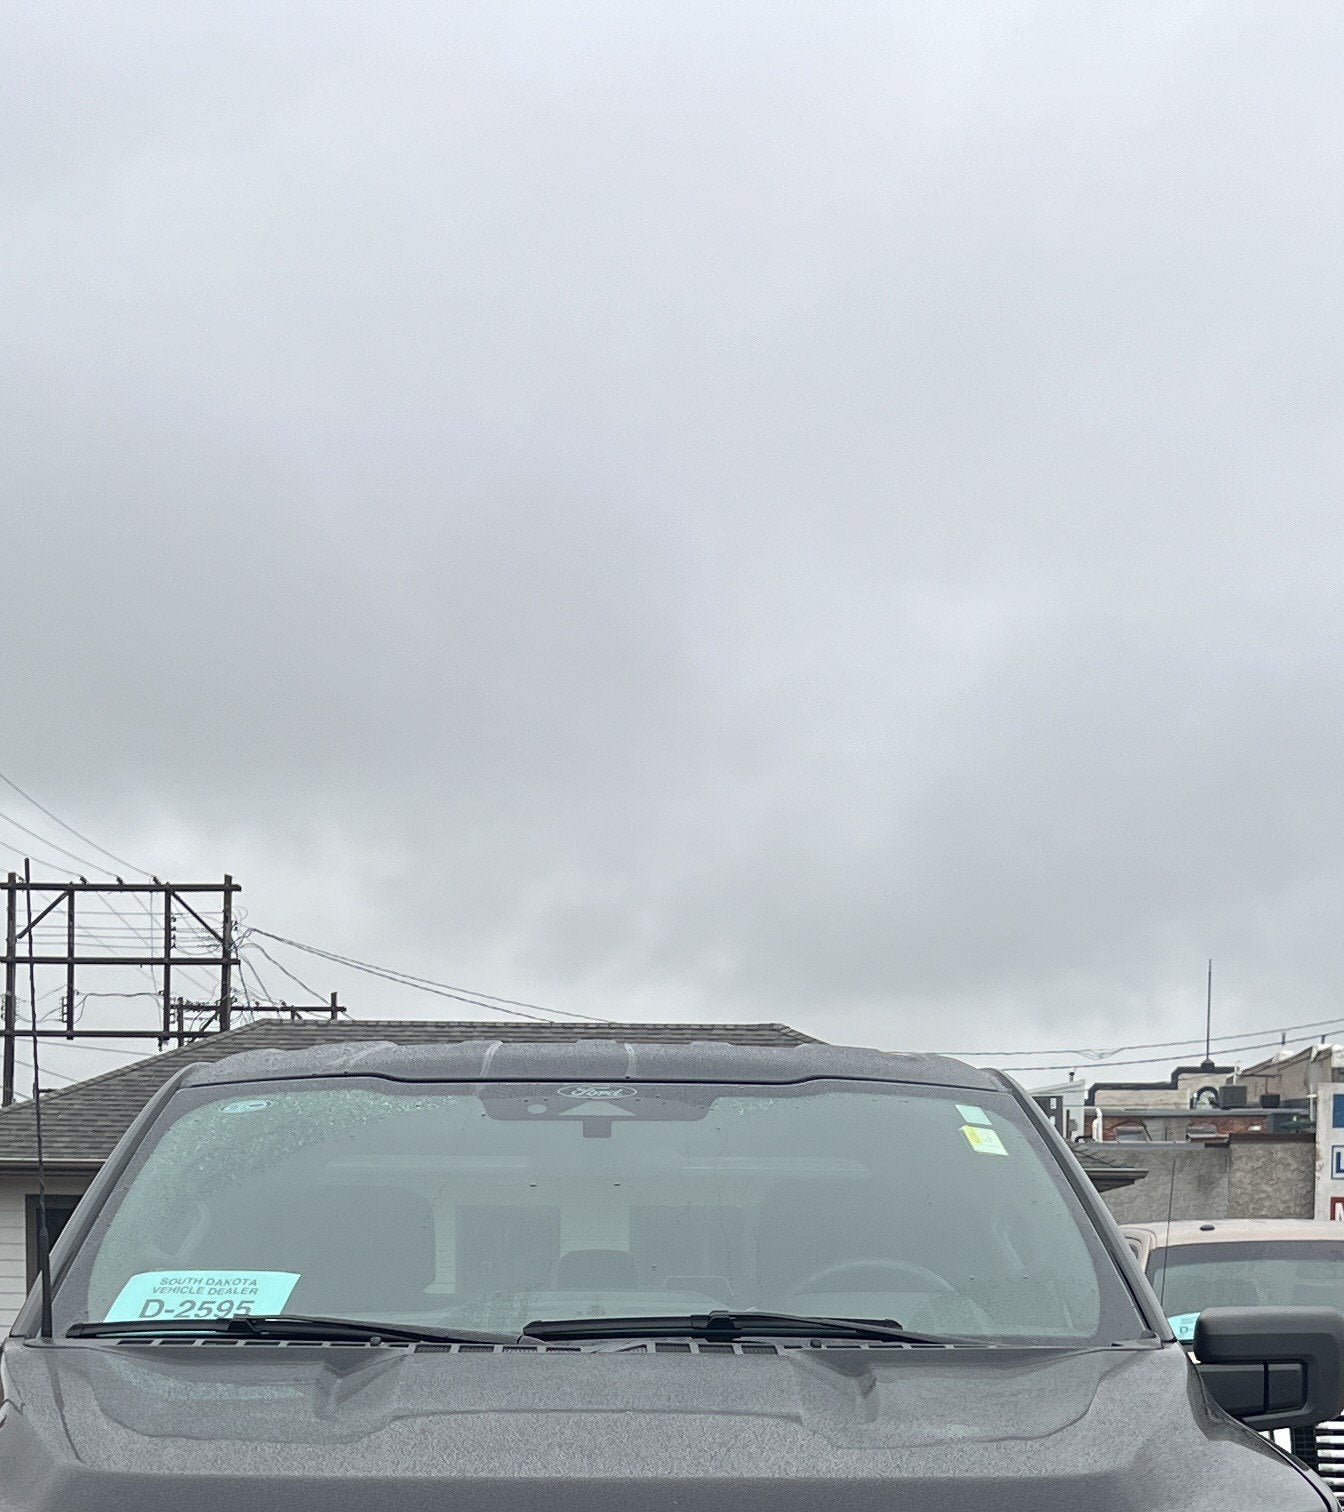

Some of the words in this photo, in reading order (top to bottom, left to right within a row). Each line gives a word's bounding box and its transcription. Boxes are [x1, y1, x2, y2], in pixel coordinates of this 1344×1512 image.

[570, 1085, 623, 1097] Ford
[159, 1277, 204, 1286] SOUTH
[206, 1277, 258, 1287] DAKOTA
[152, 1286, 205, 1295] VEHICLE
[207, 1286, 259, 1296] DEALER
[138, 1298, 256, 1320] D-2595
